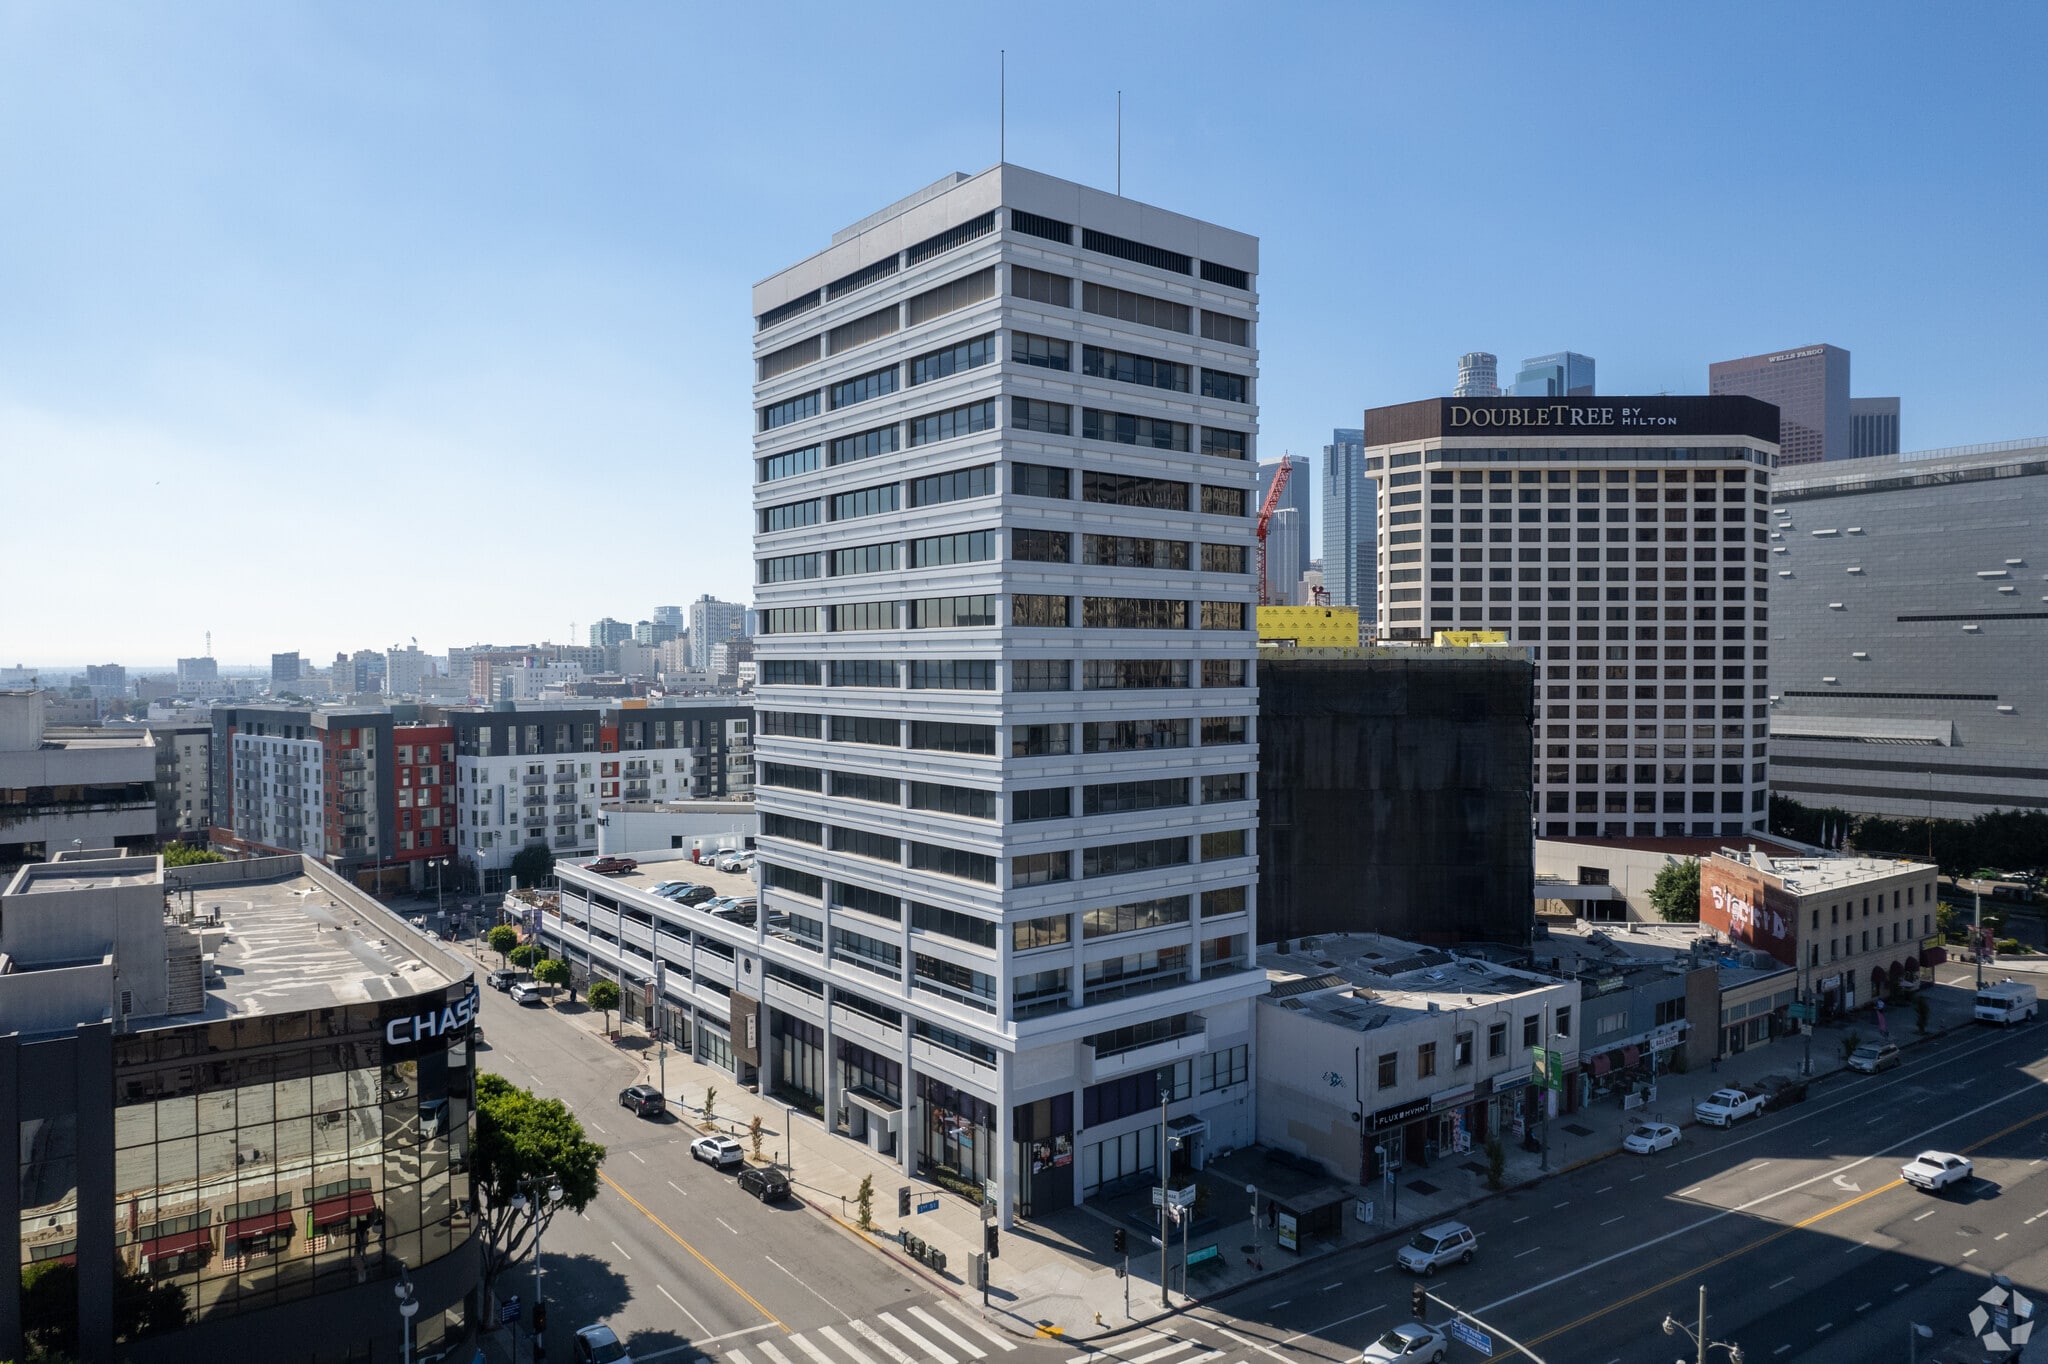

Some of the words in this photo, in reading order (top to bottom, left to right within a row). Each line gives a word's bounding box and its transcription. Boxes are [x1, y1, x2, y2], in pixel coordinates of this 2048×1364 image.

[1768, 353, 1796, 363] WELLS
[1797, 348, 1824, 358] FARGO
[1450, 405, 1615, 427] DOUBLETREE
[1622, 408, 1642, 417] BY
[1622, 417, 1678, 426] HILTON
[386, 992, 477, 1046] CHASE
[1379, 1113, 1399, 1125] FLUX
